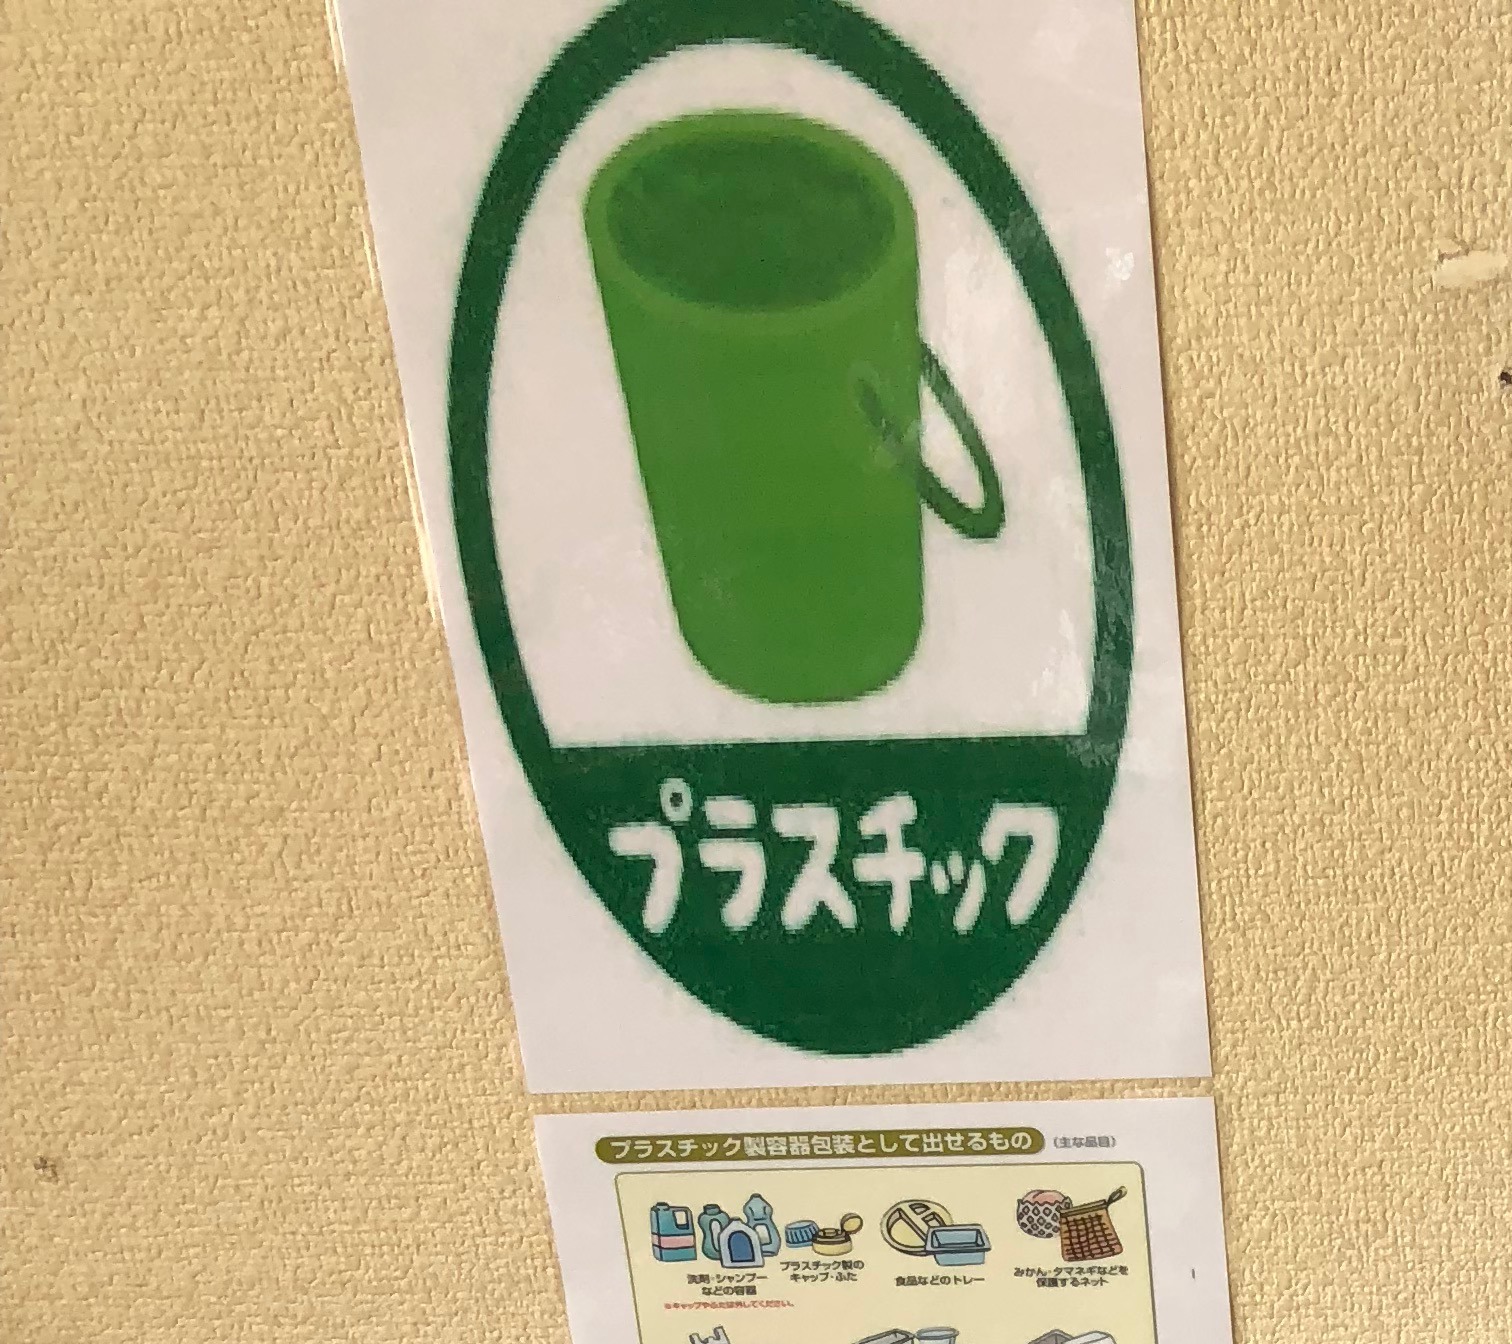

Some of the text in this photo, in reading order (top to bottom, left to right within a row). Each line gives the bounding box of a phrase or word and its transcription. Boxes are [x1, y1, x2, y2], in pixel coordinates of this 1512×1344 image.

[608, 777, 1059, 934] プラスチック
[610, 1131, 1032, 1159] プラスチック製容器包装として出せるもの
[895, 1275, 985, 1287] 食品などのトレー
